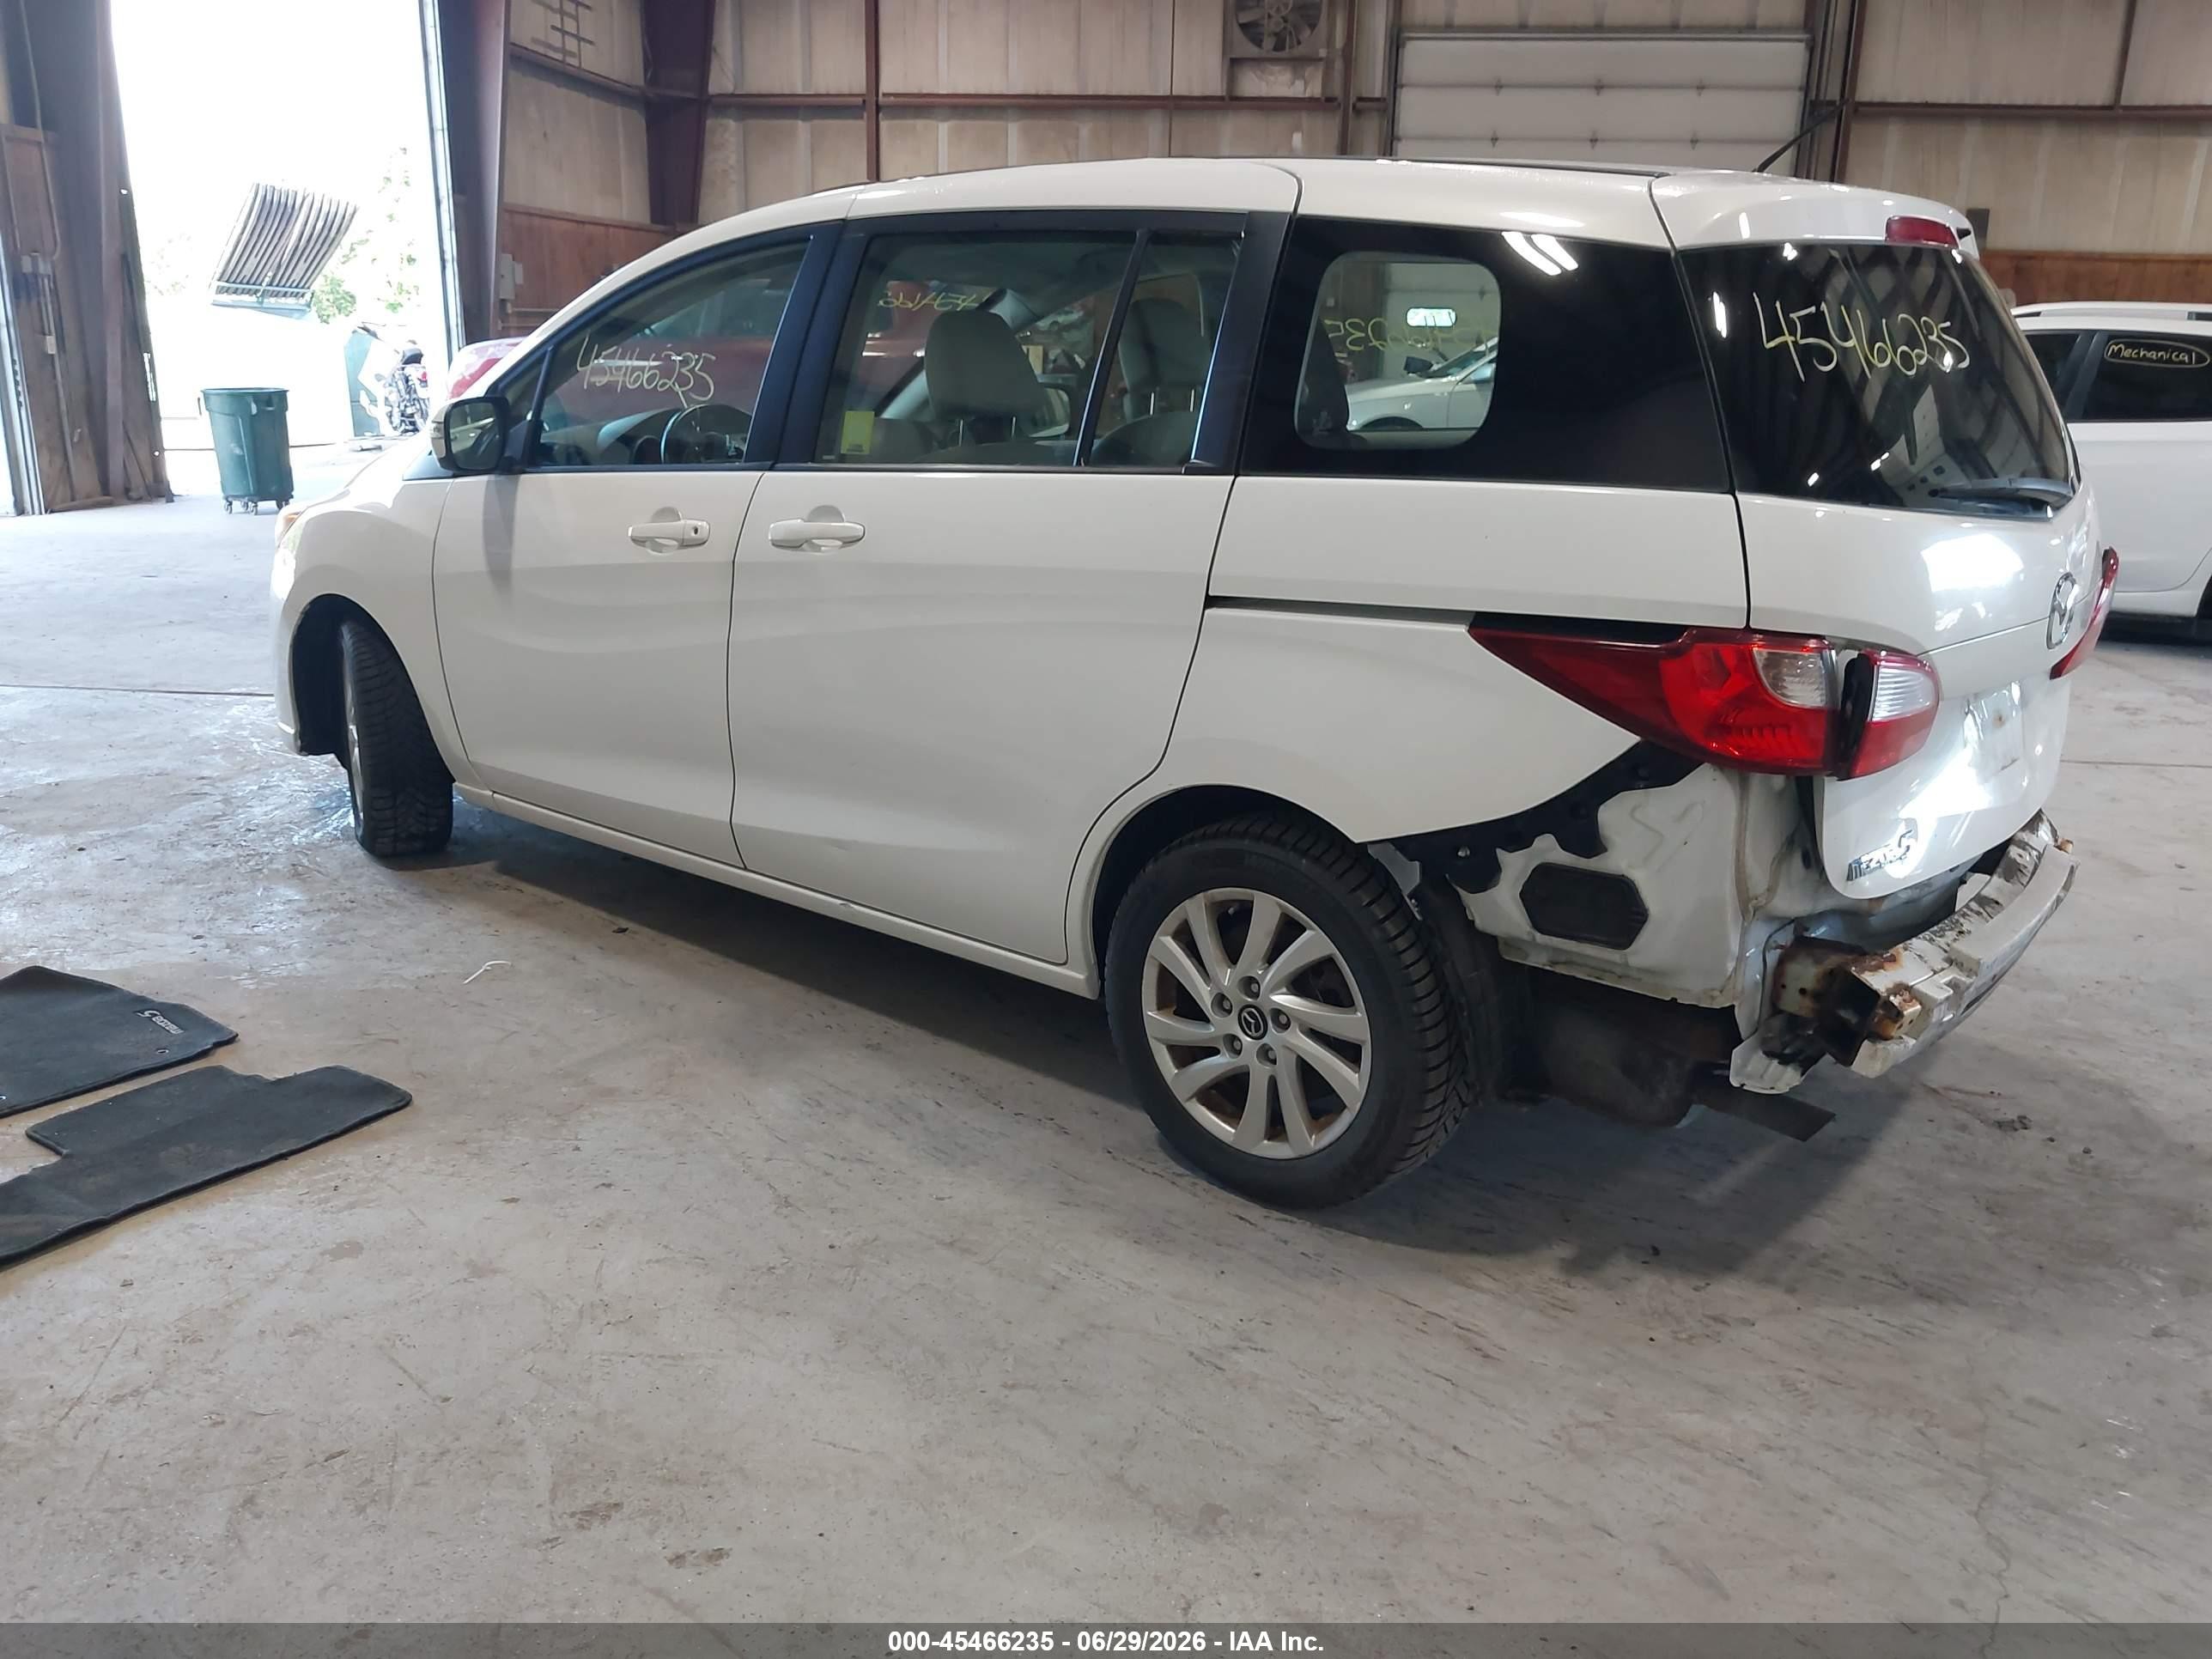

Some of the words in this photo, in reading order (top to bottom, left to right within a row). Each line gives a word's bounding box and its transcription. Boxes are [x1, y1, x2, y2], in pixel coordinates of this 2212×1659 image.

[577, 330, 716, 401] 45466235
[1753, 292, 1970, 382] 45466235
[2107, 343, 2196, 365] Mechanical
